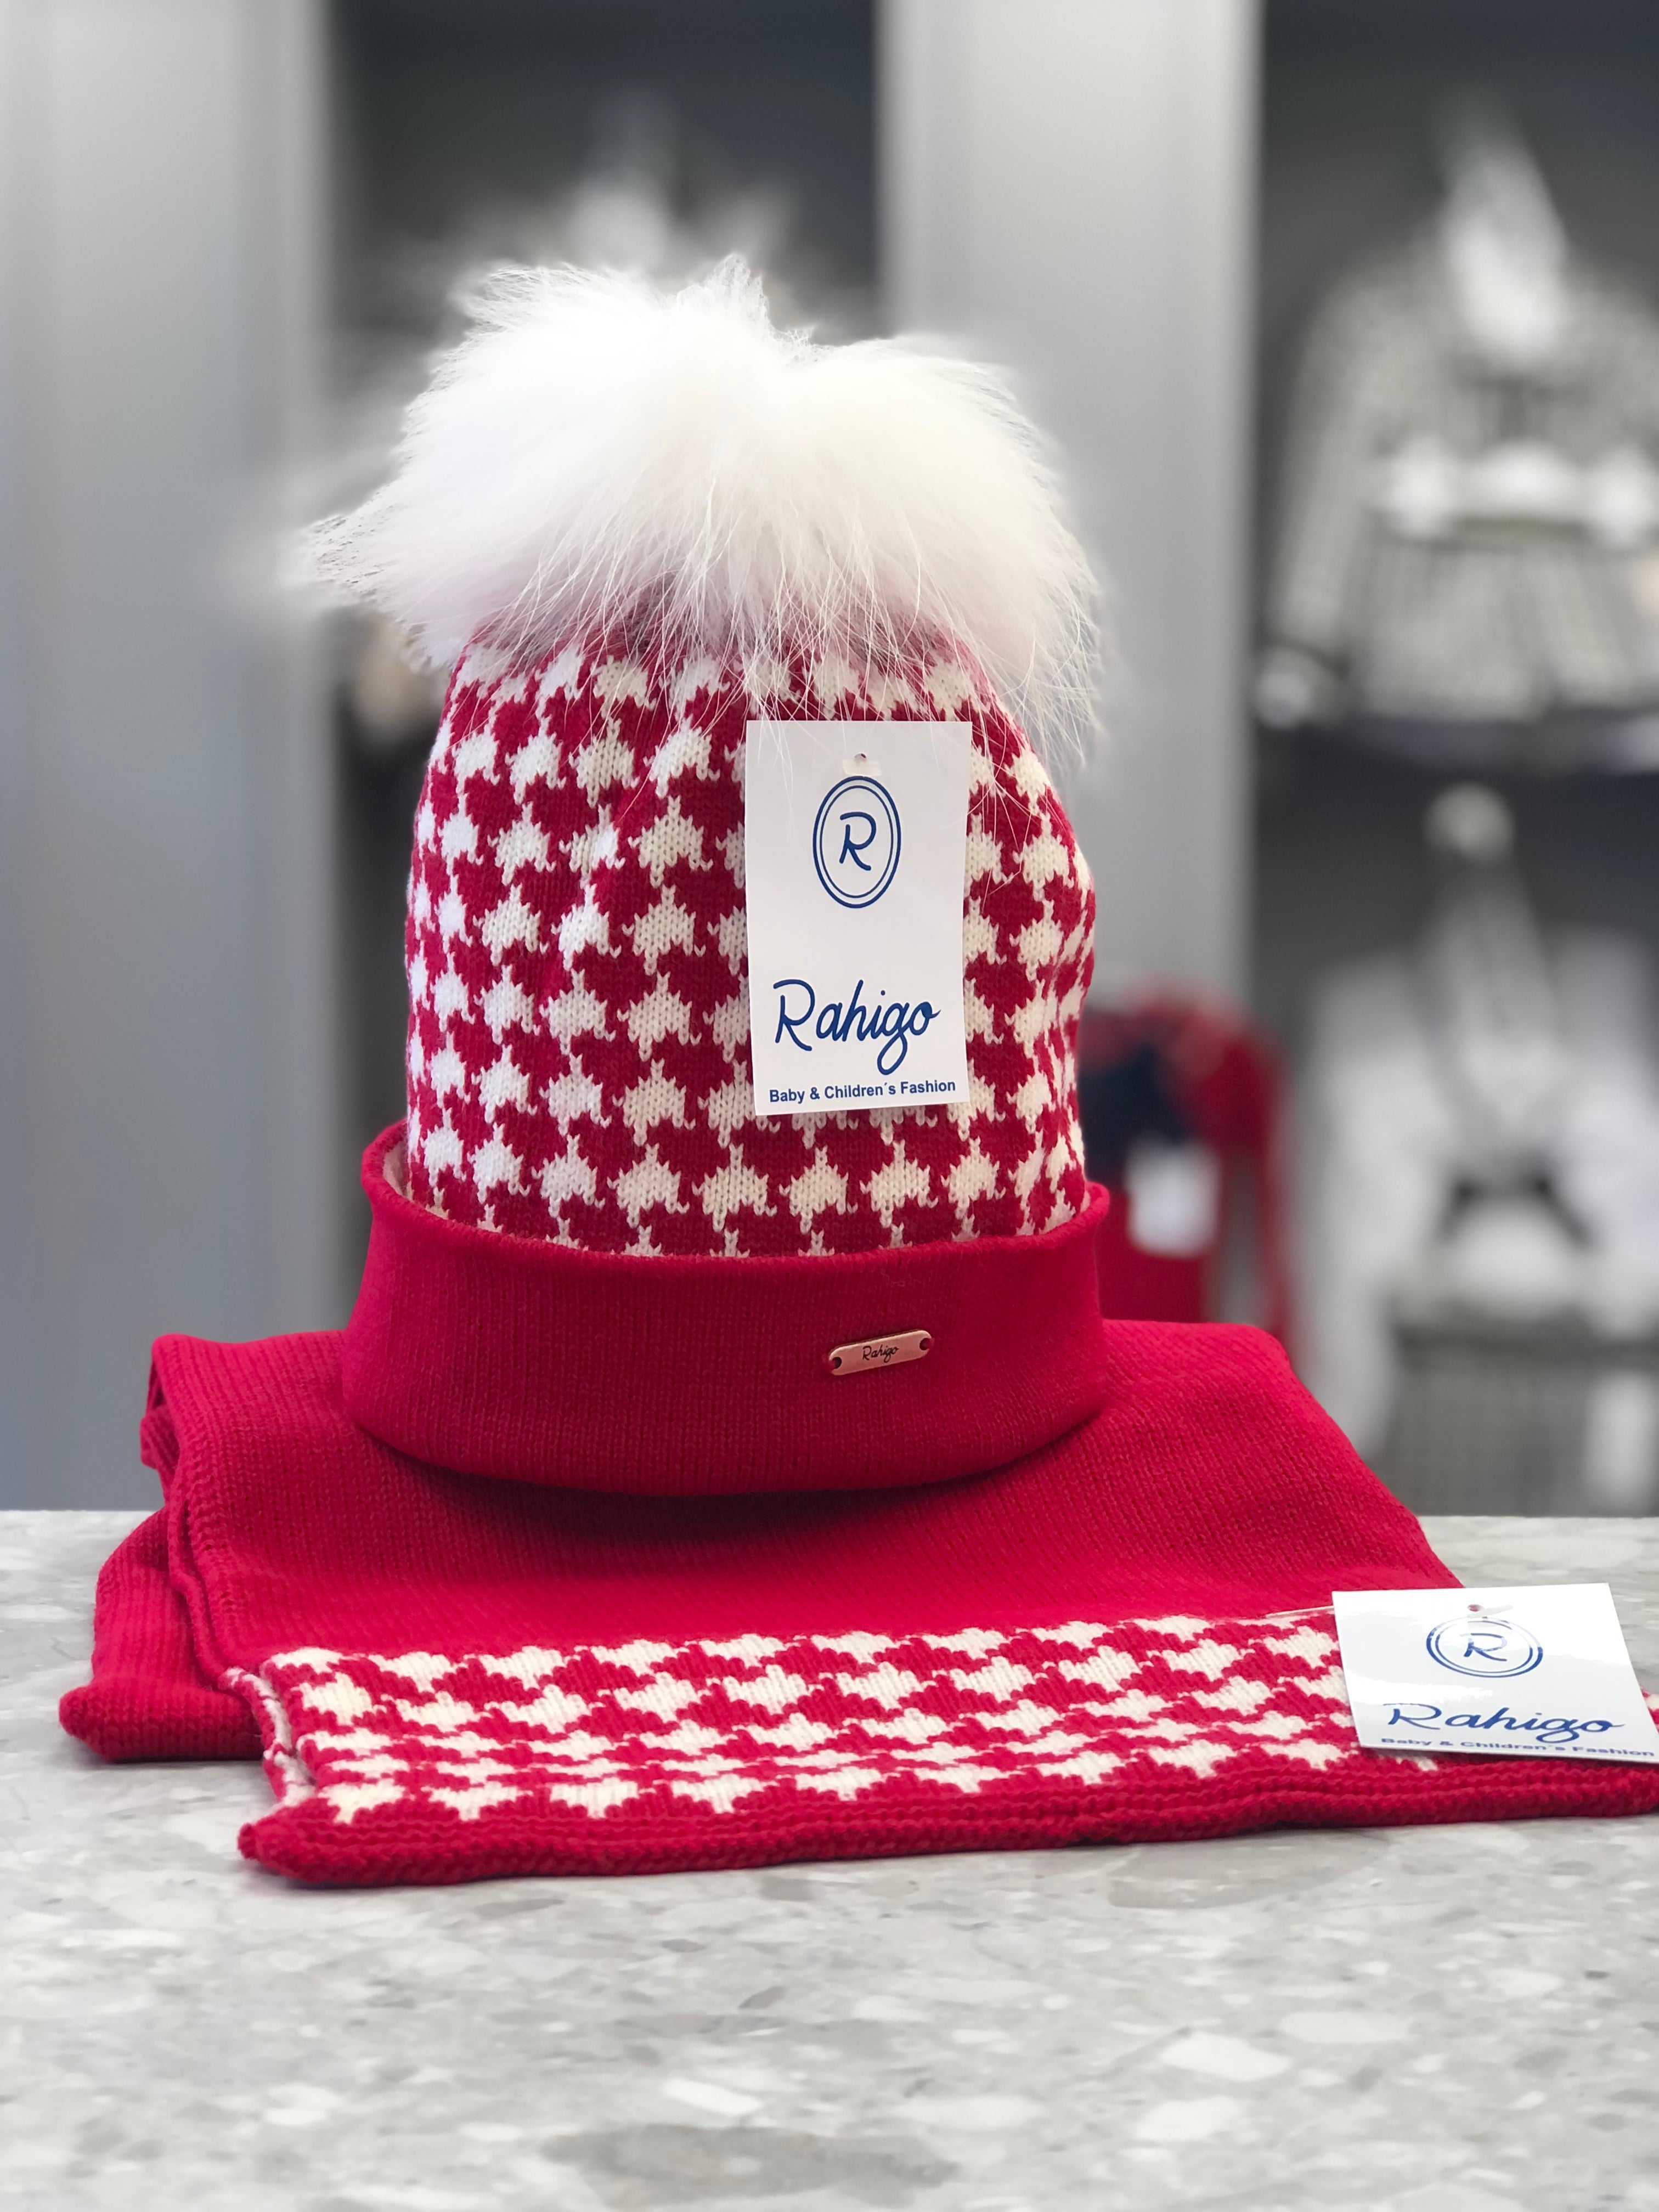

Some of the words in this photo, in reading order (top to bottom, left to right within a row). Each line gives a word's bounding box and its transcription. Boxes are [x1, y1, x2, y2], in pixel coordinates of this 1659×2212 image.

[839, 812, 876, 871] R
[773, 979, 941, 1075] Rahigo
[769, 1090, 805, 1103] Baby
[810, 1087, 821, 1100] &
[900, 1080, 956, 1094] Fashion
[862, 1345, 899, 1363] Rahigo
[1460, 1633, 1508, 1662] R
[1383, 1703, 1626, 1743] Rahigo
[1381, 1738, 1432, 1747] Baby
[1572, 1746, 1655, 1757] Fashion
